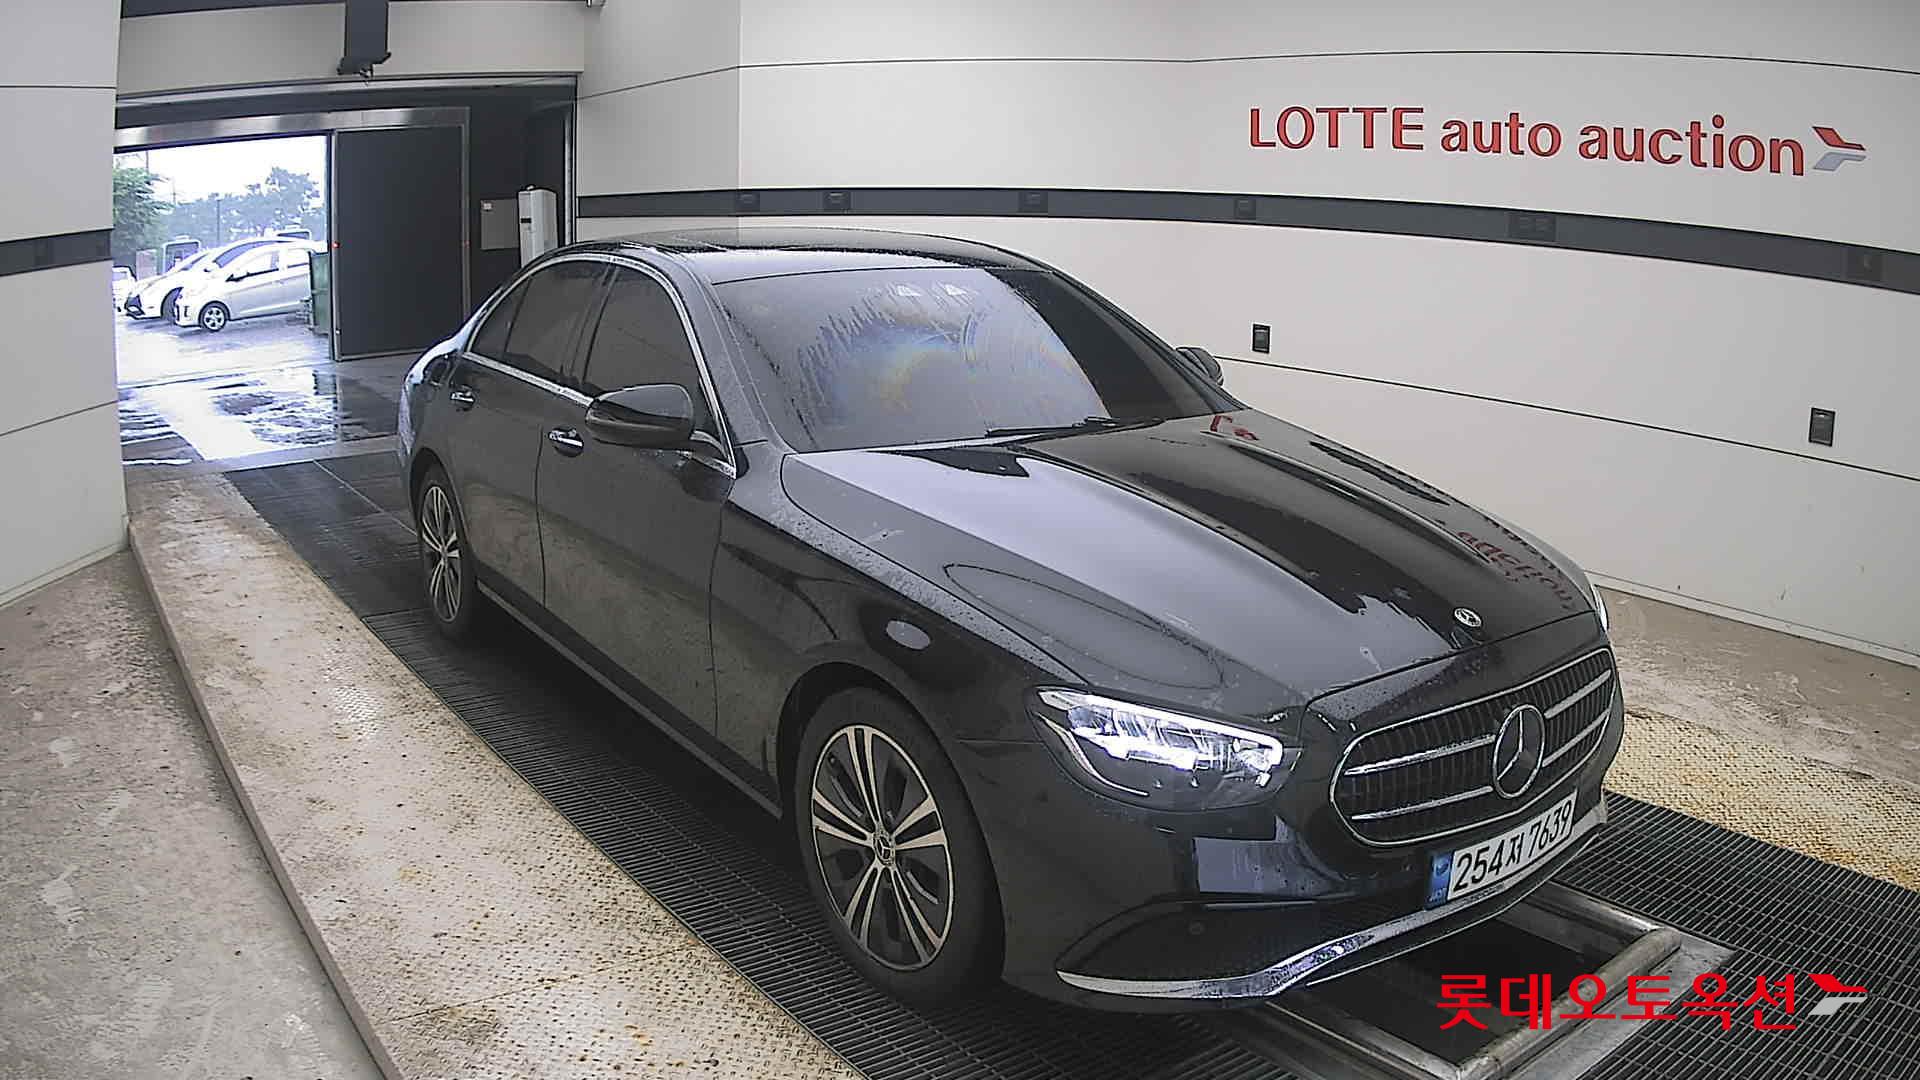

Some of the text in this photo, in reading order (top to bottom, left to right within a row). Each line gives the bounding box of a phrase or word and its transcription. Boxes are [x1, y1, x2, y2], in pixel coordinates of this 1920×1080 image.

[1249, 106, 1805, 176] LOTTE auto auction
[1527, 800, 1573, 859] 7639
